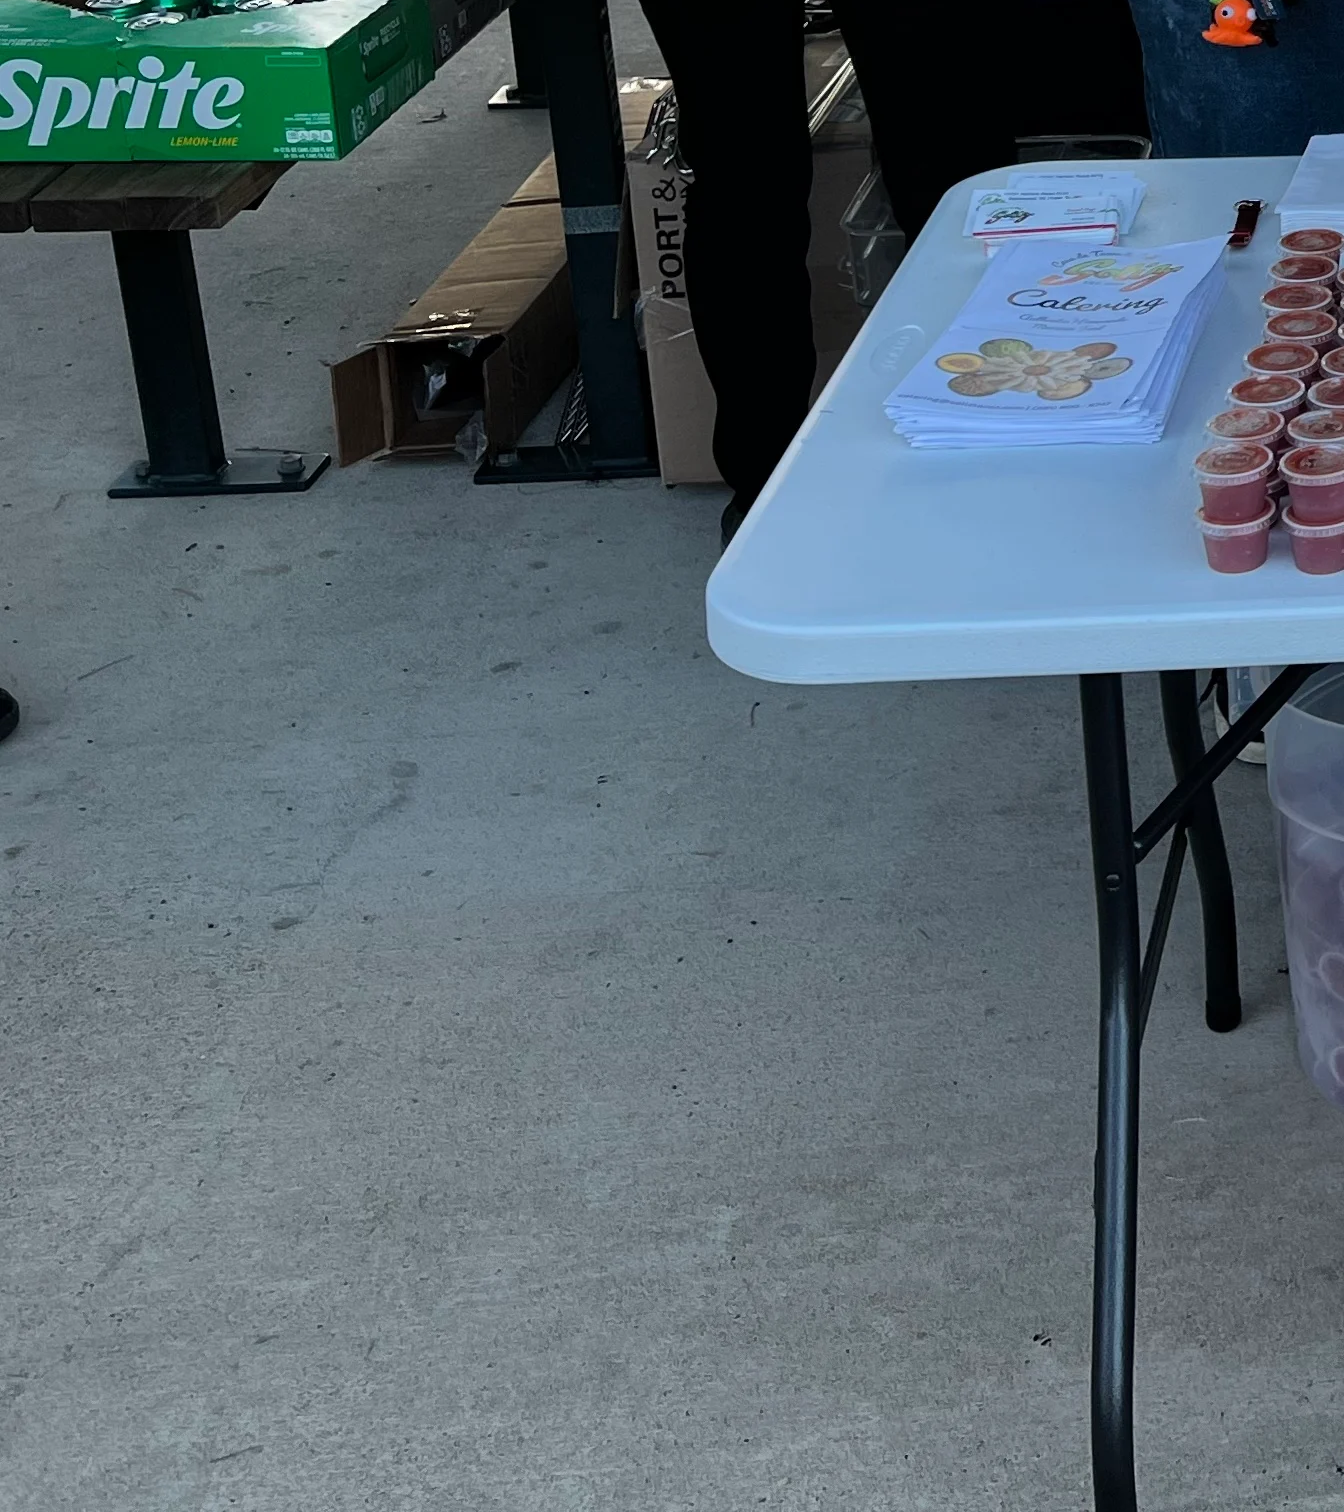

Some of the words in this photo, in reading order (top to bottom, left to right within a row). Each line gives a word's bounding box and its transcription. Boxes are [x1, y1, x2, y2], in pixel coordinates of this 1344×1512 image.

[0, 55, 245, 146] Sprite
[169, 136, 240, 147] LEMON-LIME
[651, 176, 677, 202] &
[653, 207, 687, 299] PORT
[1007, 288, 1168, 316] Catering
